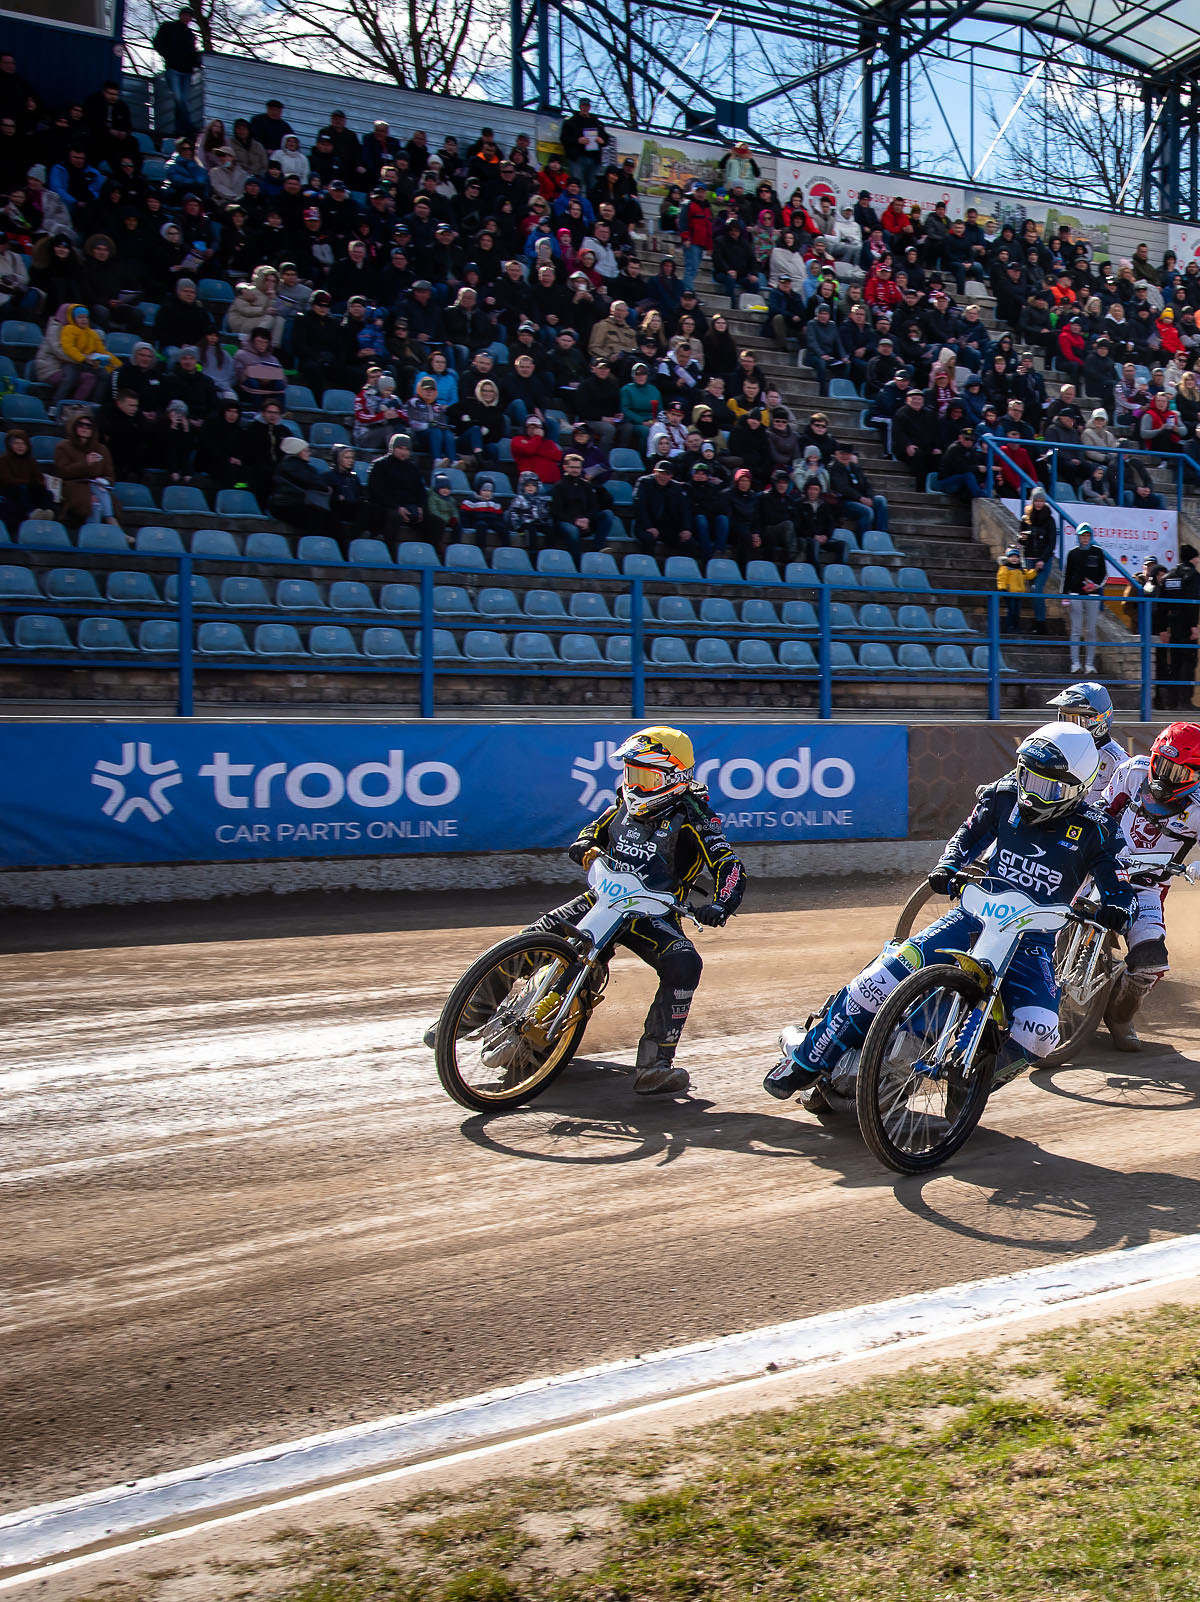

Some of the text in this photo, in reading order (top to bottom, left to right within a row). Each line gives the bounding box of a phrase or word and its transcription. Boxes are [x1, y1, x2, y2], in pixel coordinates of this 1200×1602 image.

[199, 749, 461, 809] trodo
[691, 747, 856, 800] rodo
[215, 819, 460, 844] CAR PARTS ONLINE
[780, 809, 854, 827] ONLINE
[808, 1012, 844, 1063] CHEMART
